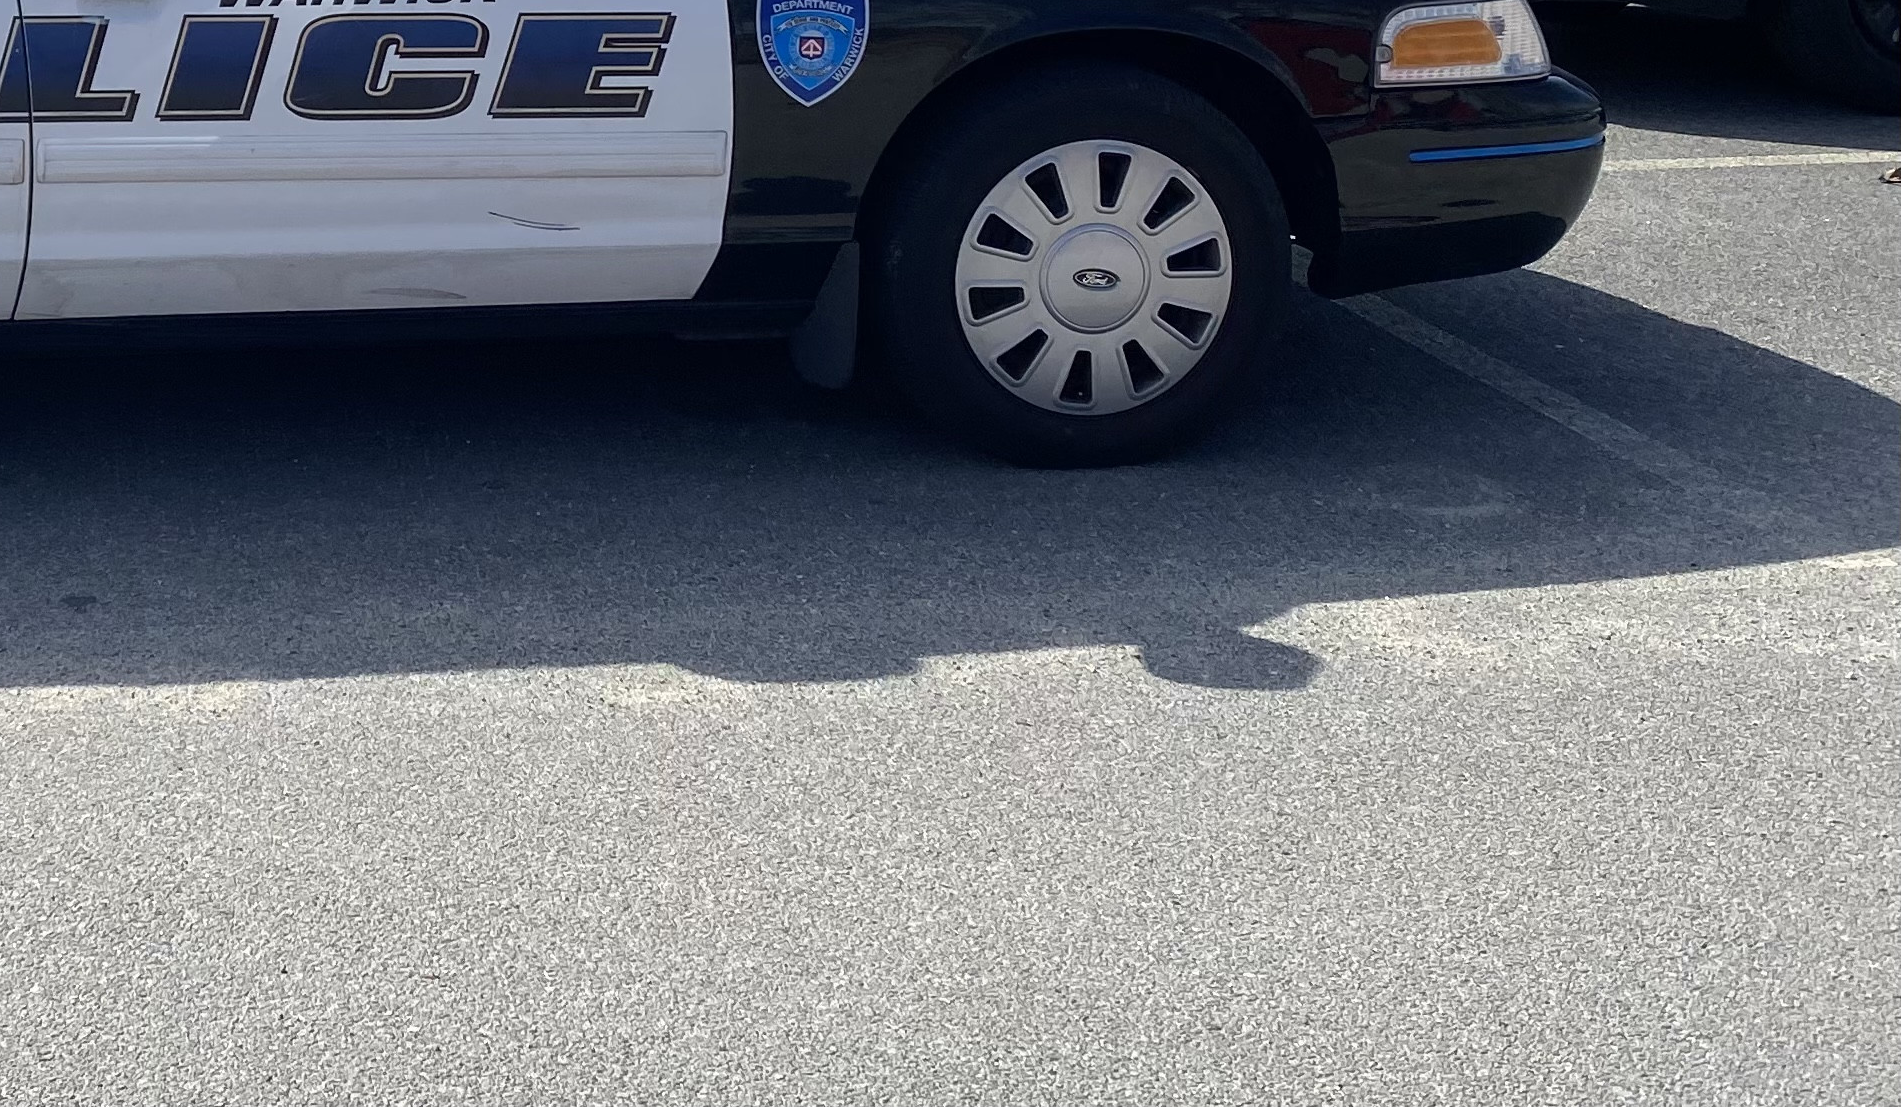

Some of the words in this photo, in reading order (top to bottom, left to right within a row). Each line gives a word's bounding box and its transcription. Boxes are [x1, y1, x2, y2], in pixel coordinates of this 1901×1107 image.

[762, 34, 778, 61] CITY
[773, 65, 790, 80] OF
[831, 27, 865, 82] WARWICK
